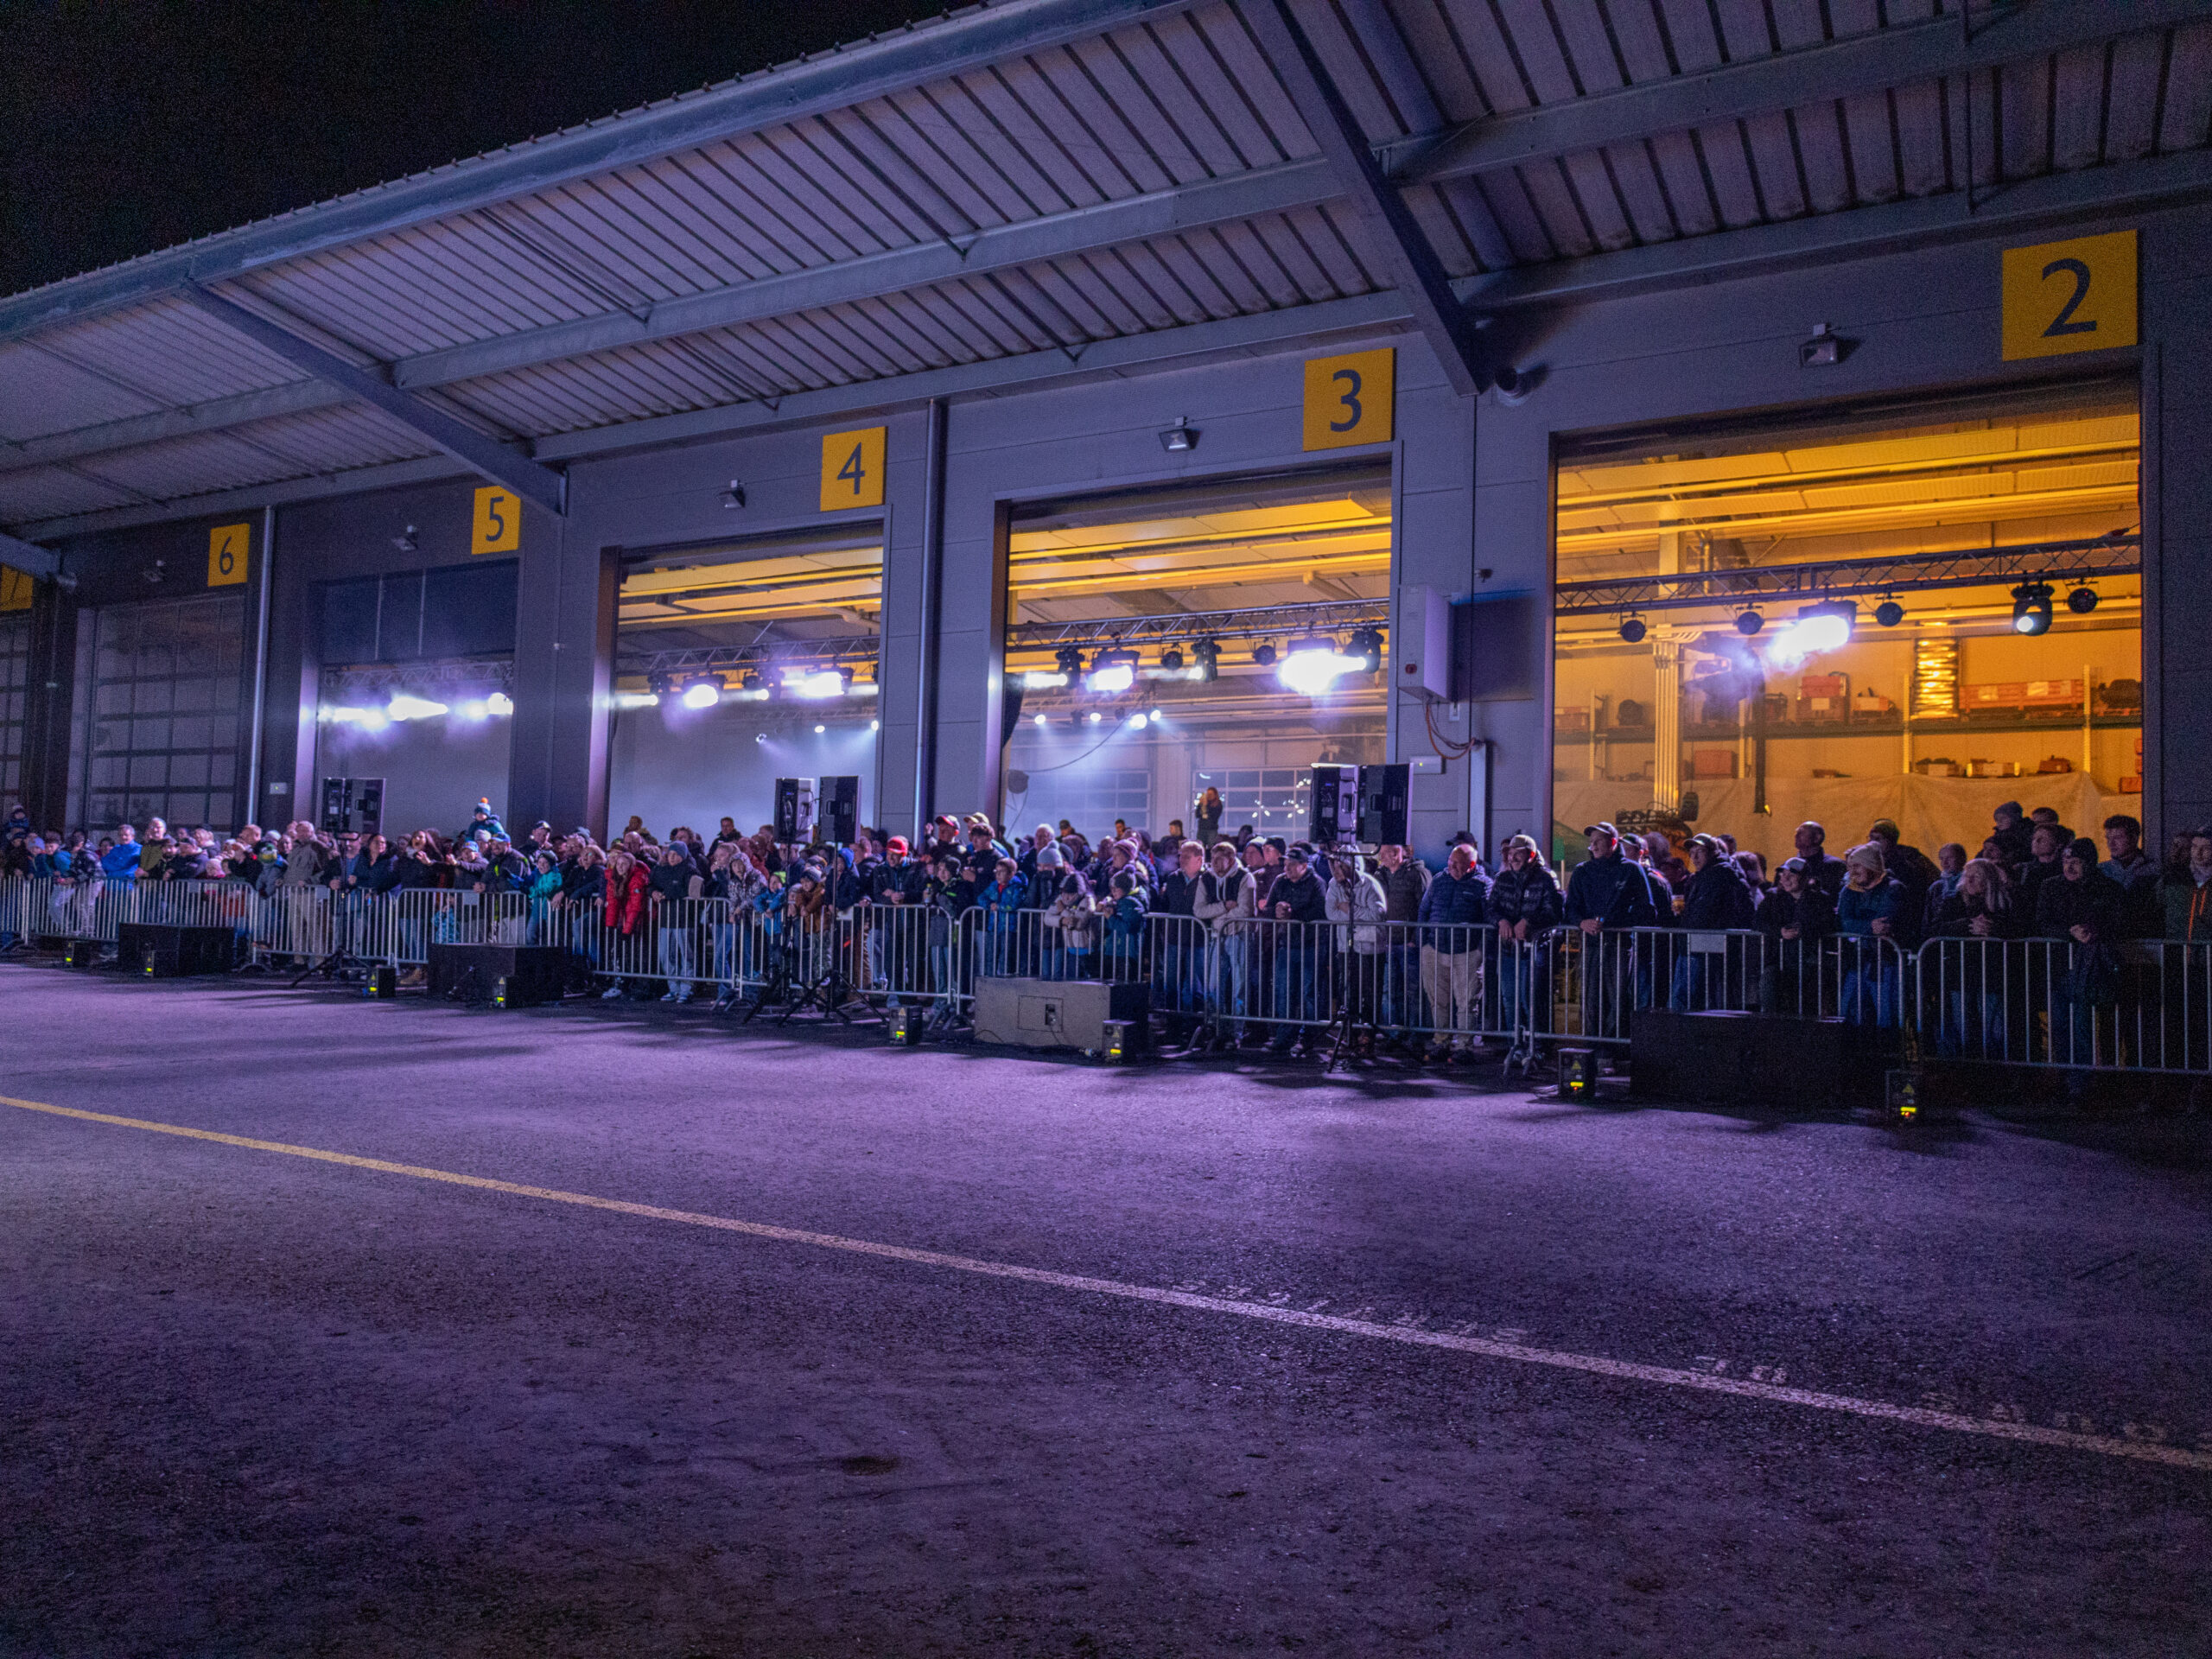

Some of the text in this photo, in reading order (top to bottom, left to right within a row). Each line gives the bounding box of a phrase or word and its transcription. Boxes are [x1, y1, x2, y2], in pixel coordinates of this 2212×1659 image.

[2041, 257, 2097, 338] 2
[1330, 369, 1362, 432] 3
[836, 442, 866, 495] 4
[486, 496, 505, 542] 5
[219, 537, 234, 575] 6
